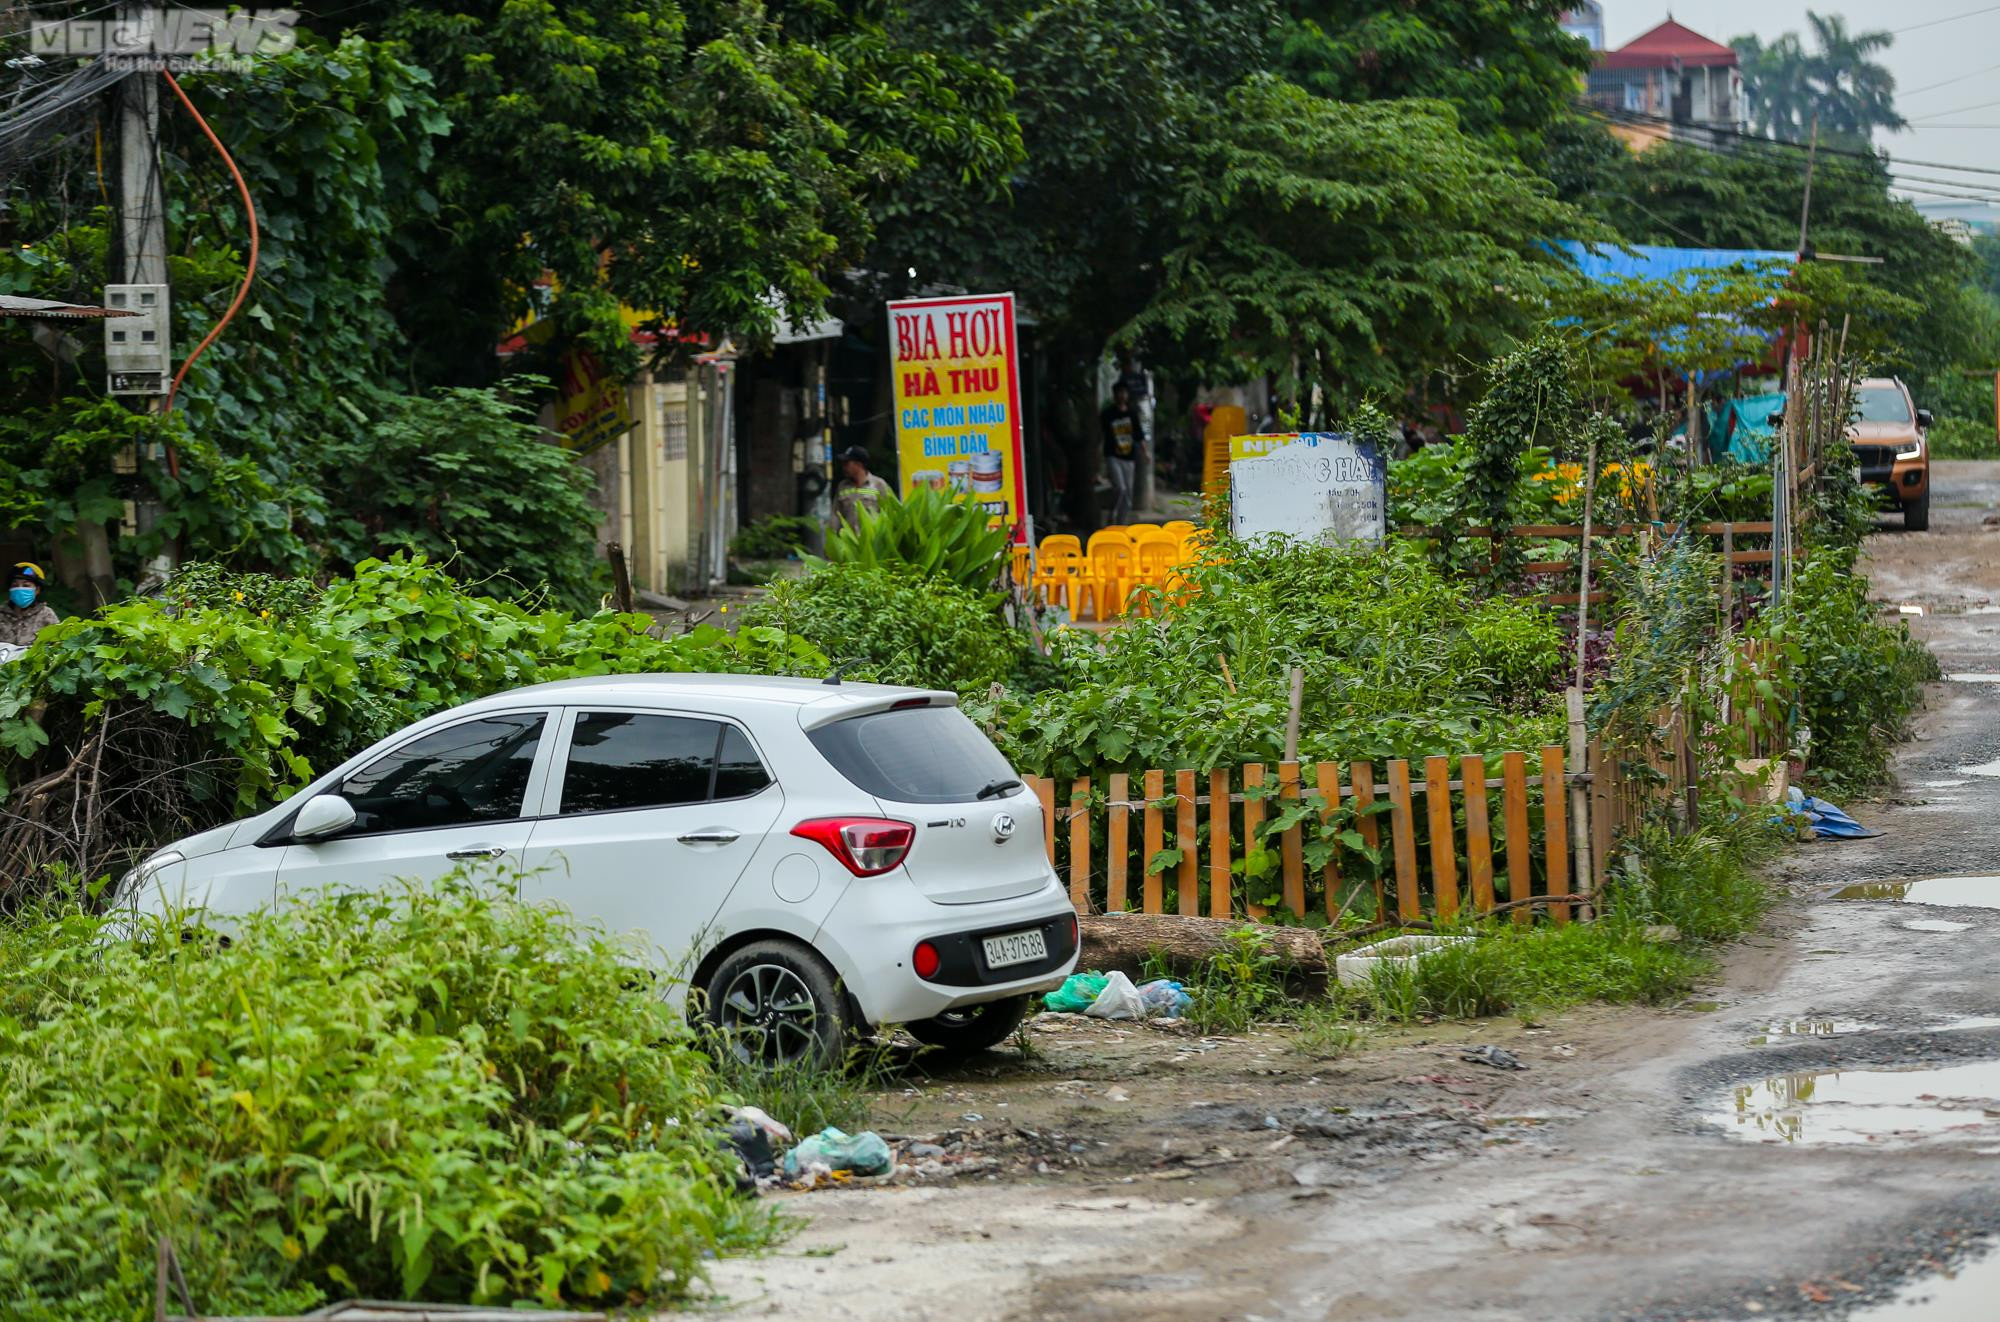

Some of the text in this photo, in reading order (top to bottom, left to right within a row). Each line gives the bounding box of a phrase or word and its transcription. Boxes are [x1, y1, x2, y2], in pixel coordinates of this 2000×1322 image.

[895, 308, 1003, 362] BIA HƠI
[903, 367, 999, 397] HÀ THU
[903, 404, 930, 429] CÁC
